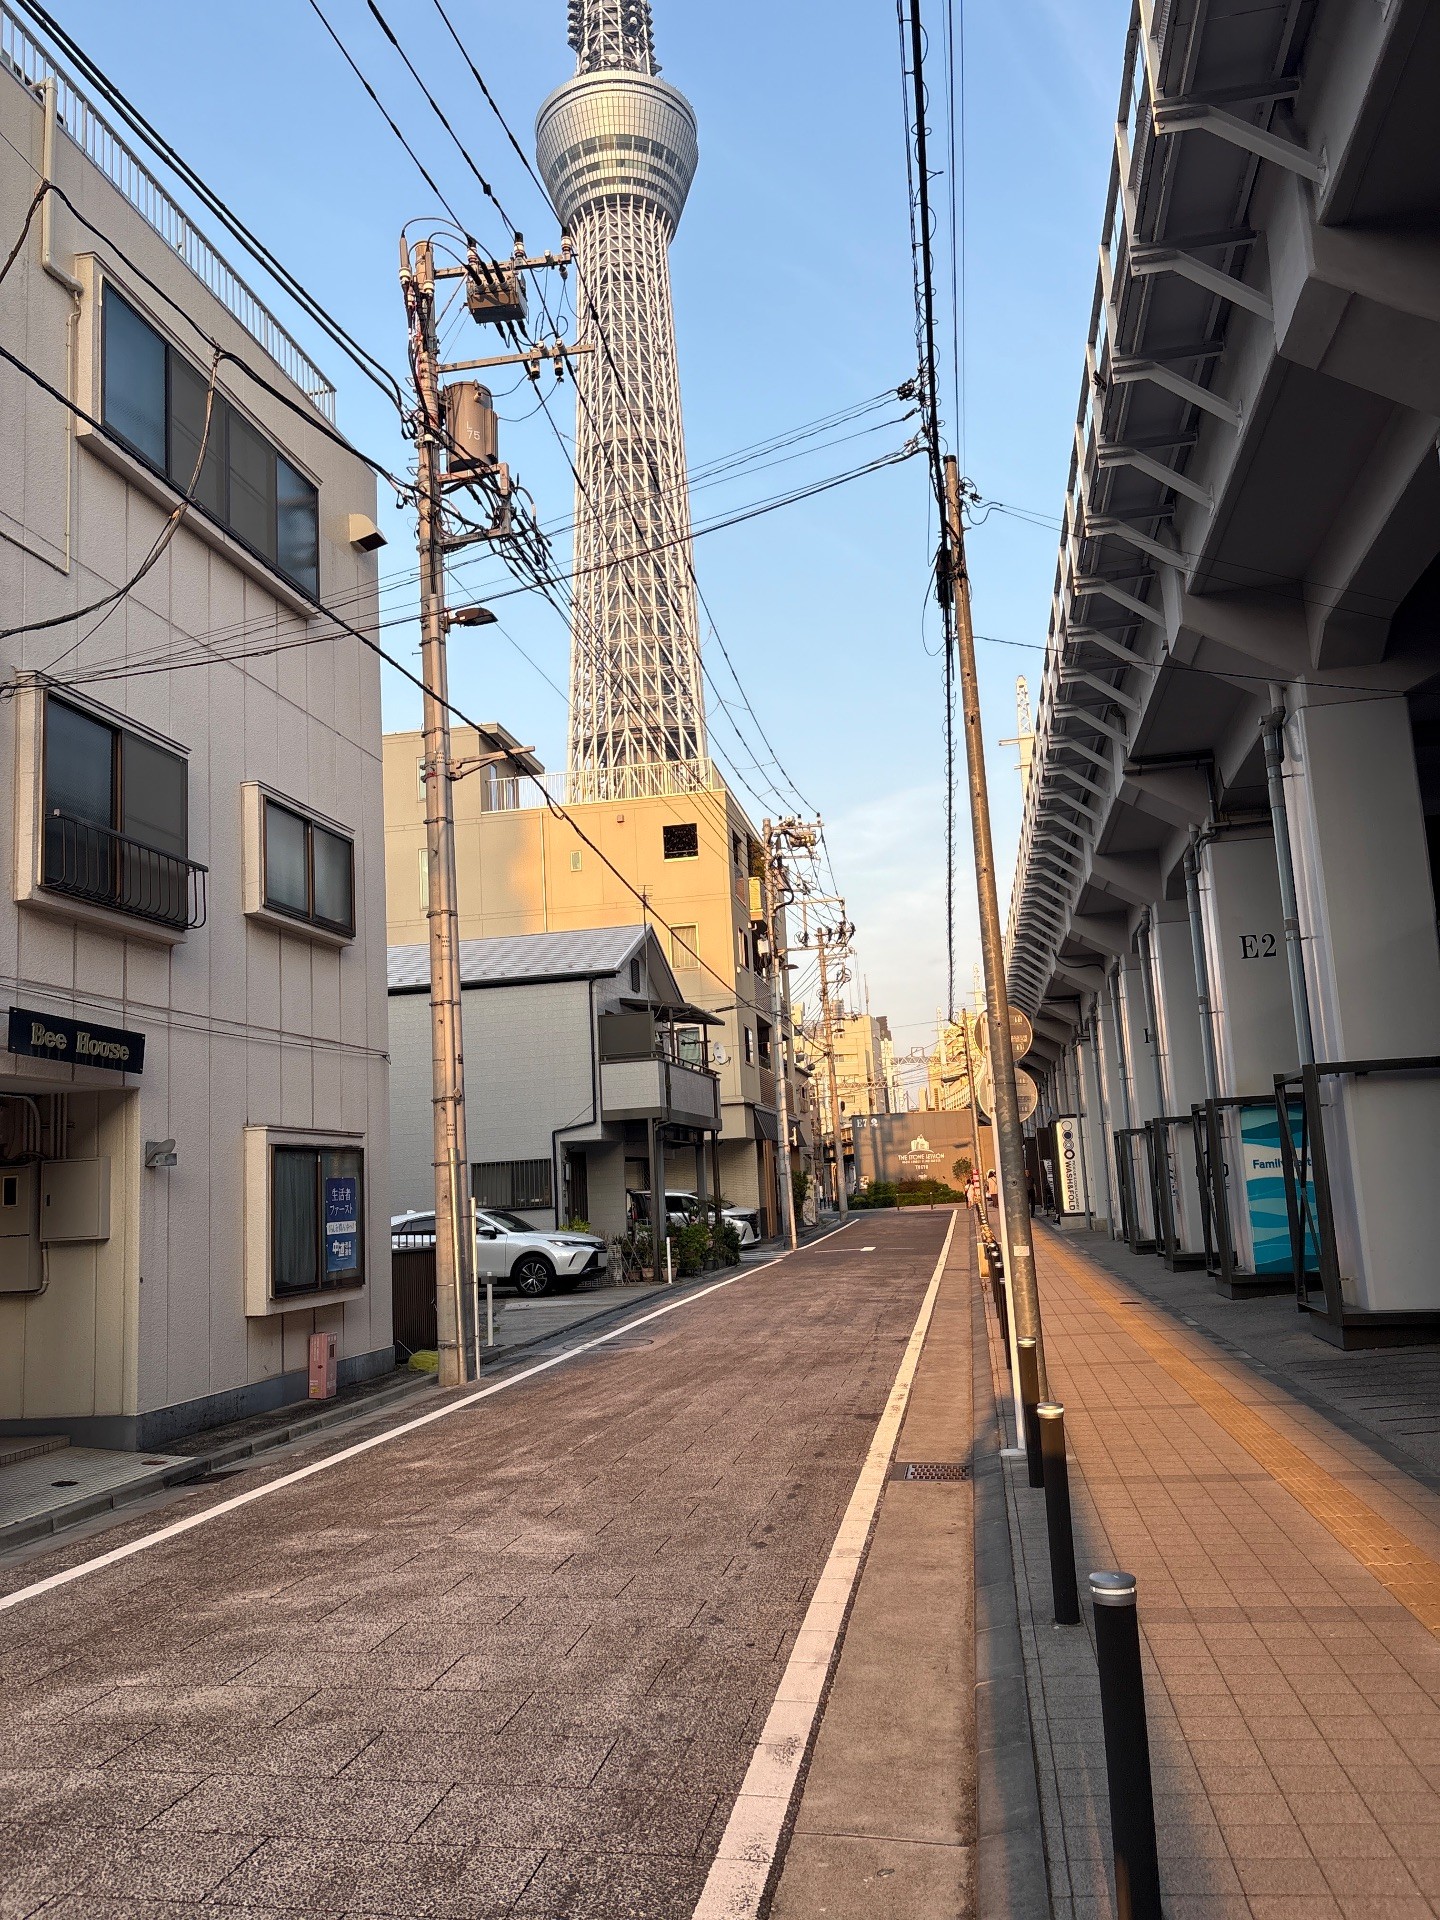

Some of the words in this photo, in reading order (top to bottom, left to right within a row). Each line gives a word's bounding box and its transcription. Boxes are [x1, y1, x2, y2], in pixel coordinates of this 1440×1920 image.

[466, 430, 480, 441] 75
[1239, 933, 1277, 960] E2
[30, 1022, 68, 1050] Bee
[75, 1030, 130, 1061] House
[856, 1118, 868, 1128] E7
[1252, 1157, 1312, 1170] Familat
[1064, 1160, 1076, 1211] WASH&FOLD
[331, 1187, 352, 1202] 生活者
[329, 1203, 353, 1216] ファースト
